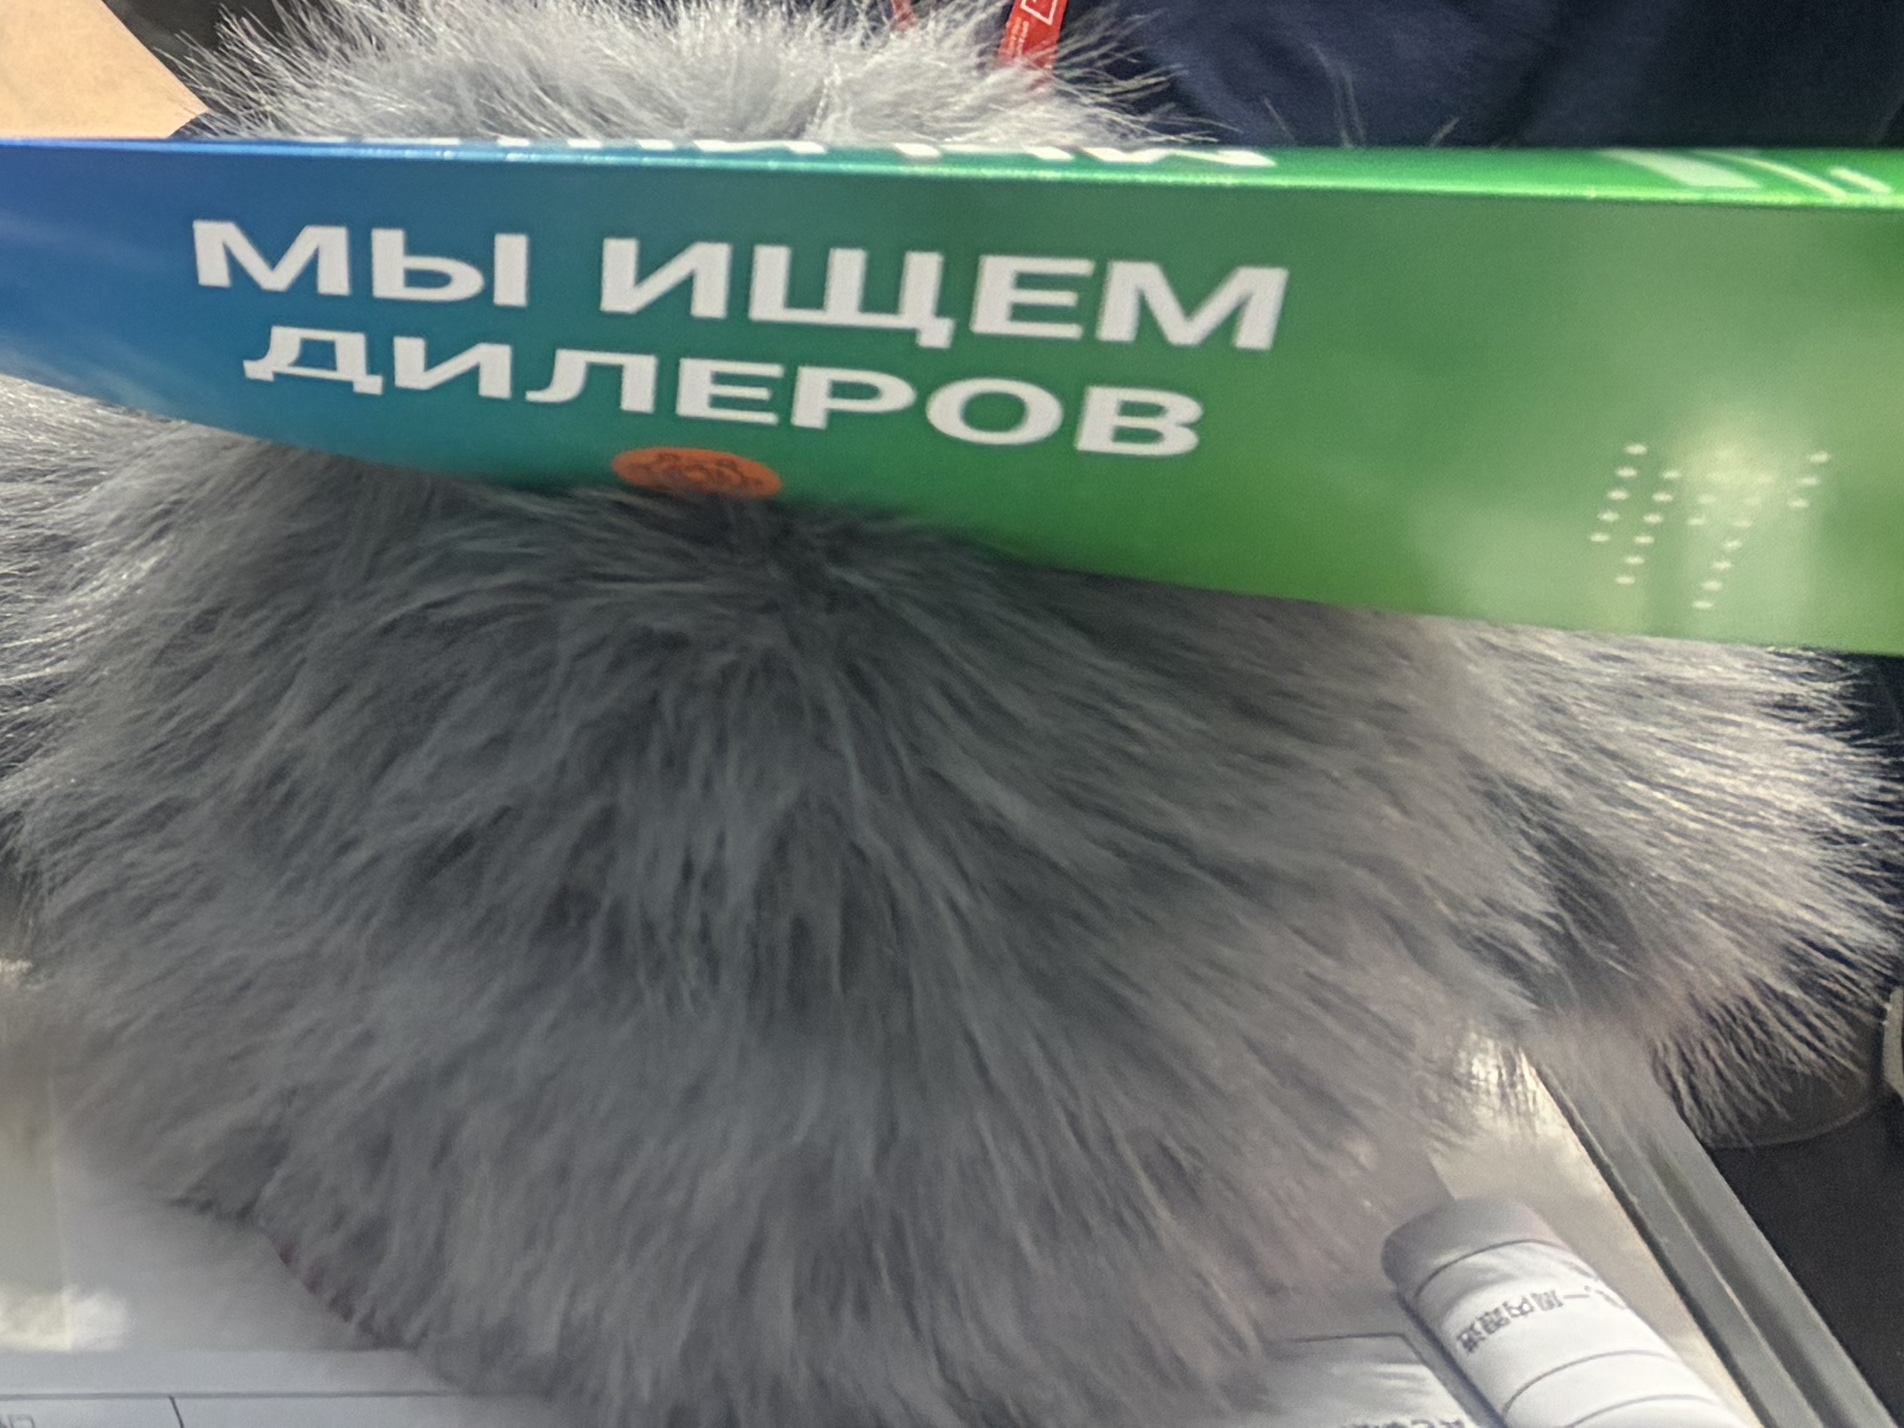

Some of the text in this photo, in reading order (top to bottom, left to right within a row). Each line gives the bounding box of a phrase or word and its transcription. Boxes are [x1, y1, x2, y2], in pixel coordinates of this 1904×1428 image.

[193, 219, 1290, 351] МЫ ИЩЕМ
[243, 325, 1205, 459] ДИЛЕРОВ
